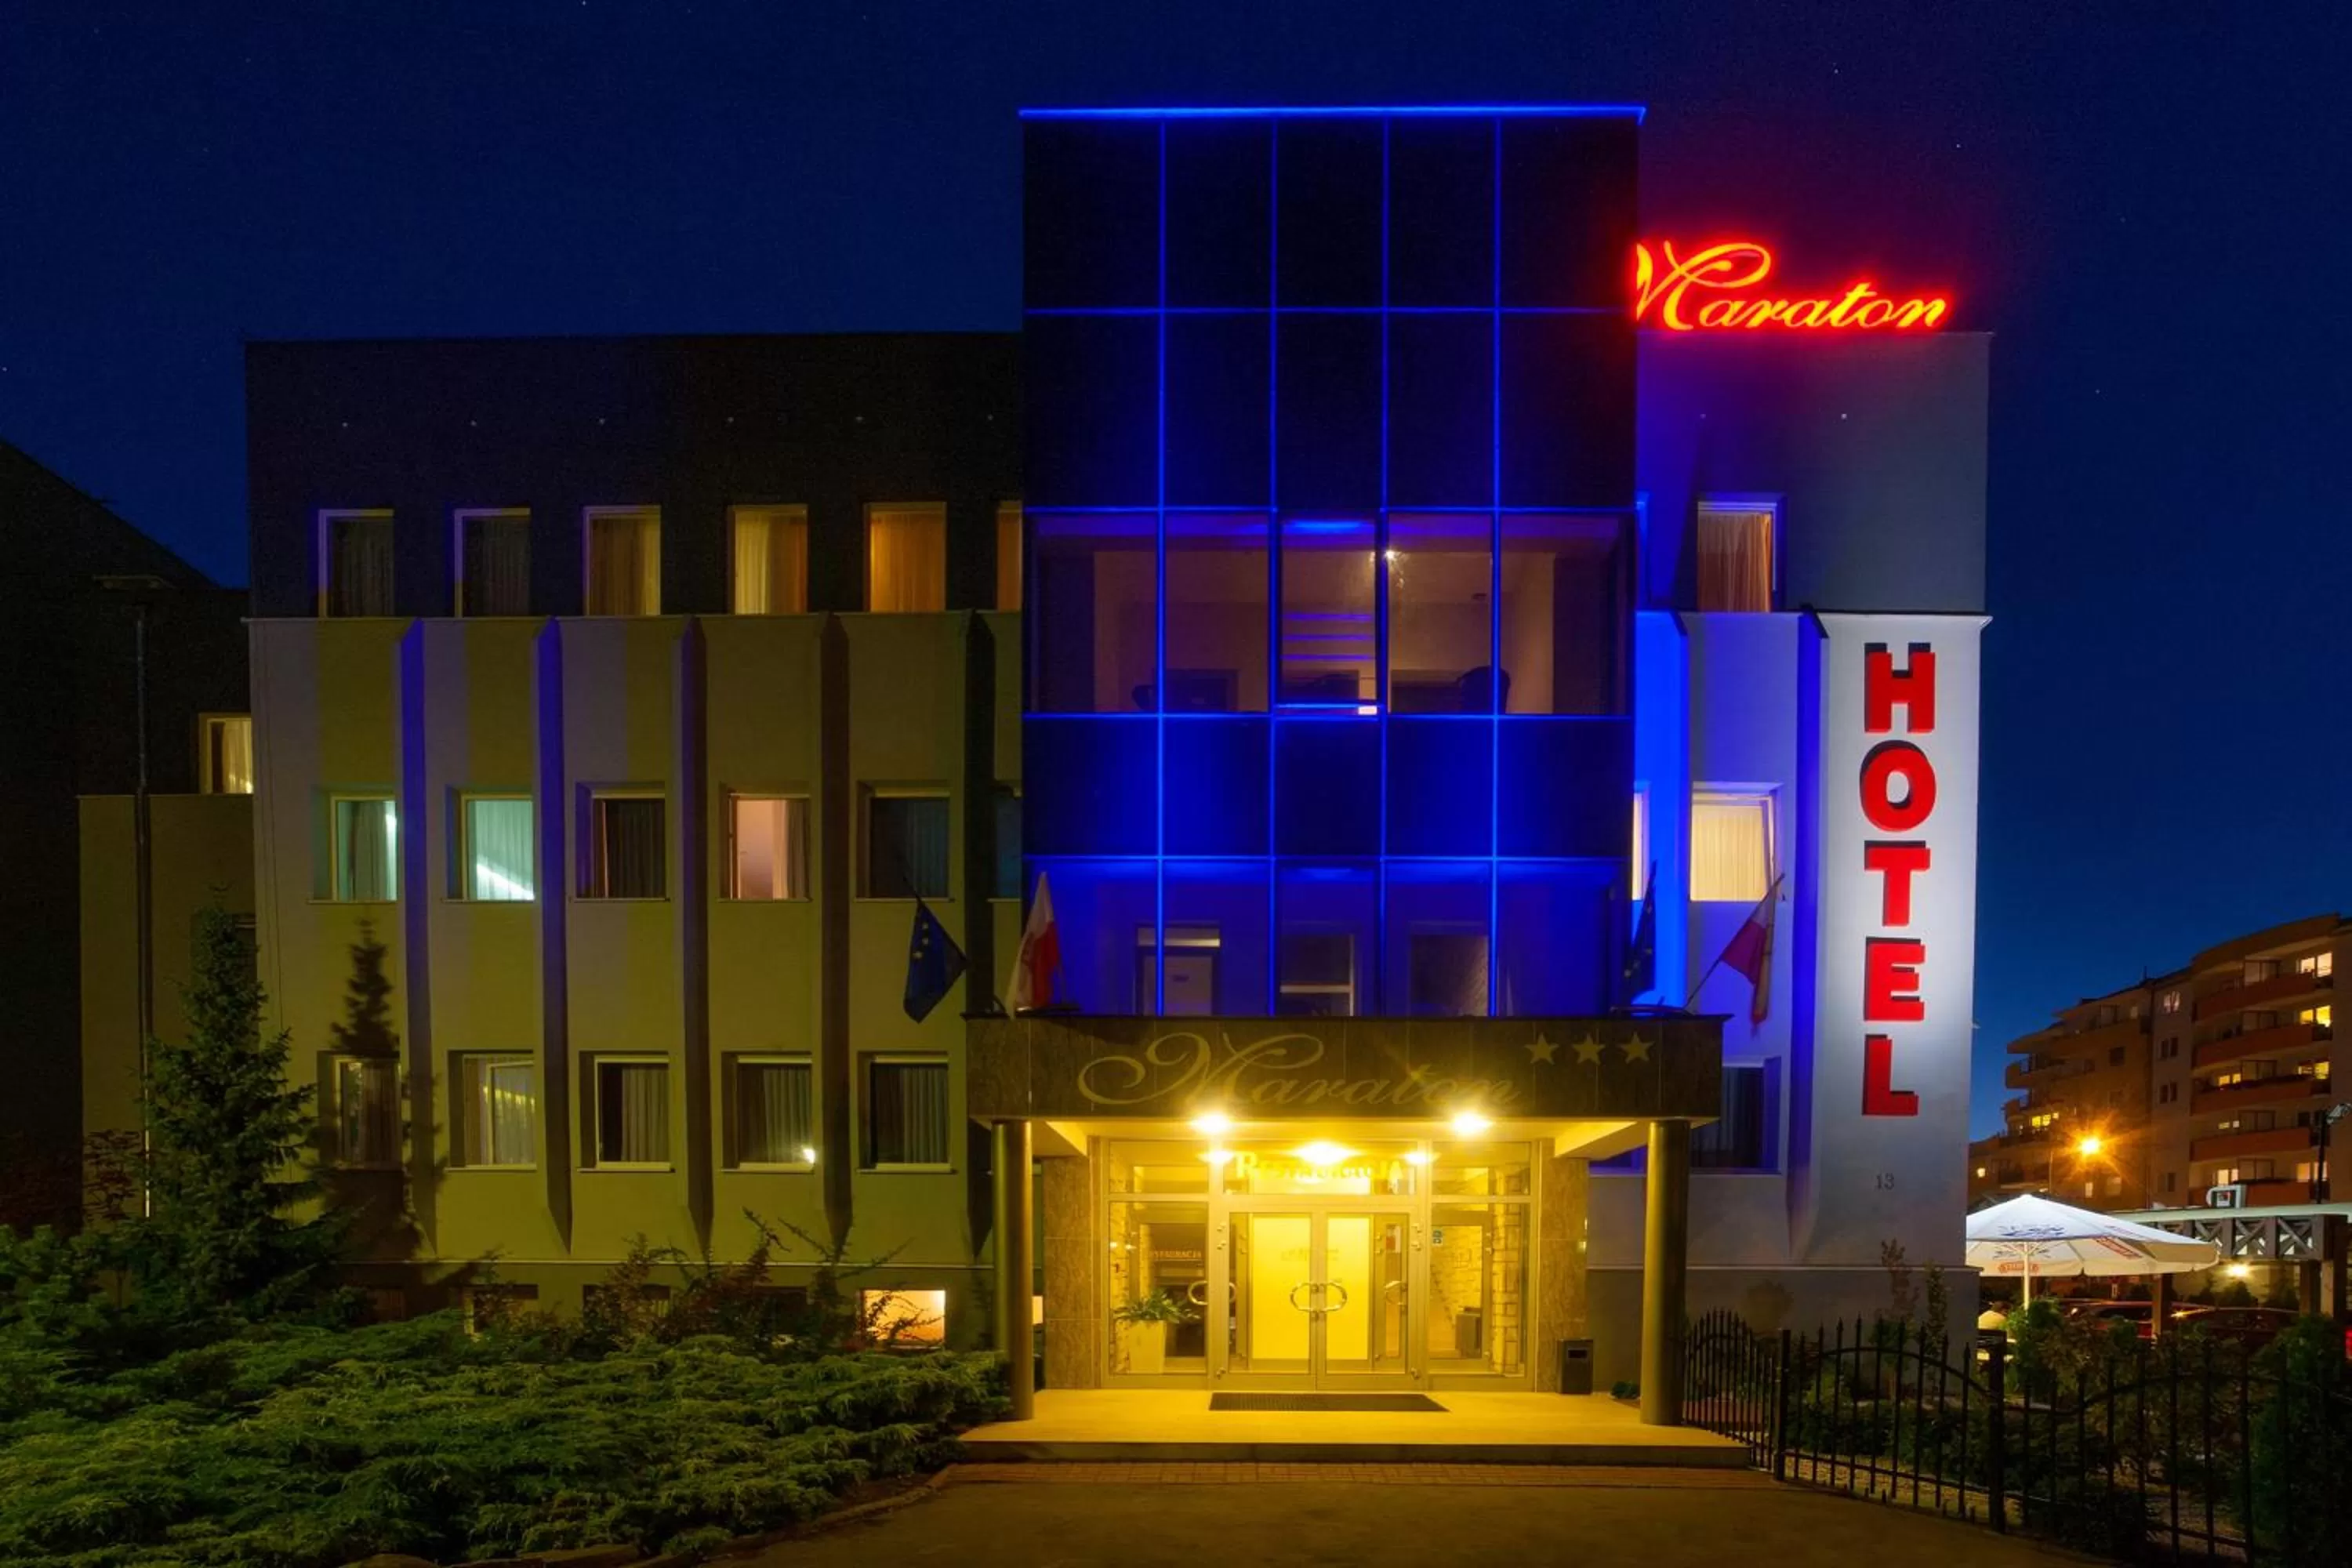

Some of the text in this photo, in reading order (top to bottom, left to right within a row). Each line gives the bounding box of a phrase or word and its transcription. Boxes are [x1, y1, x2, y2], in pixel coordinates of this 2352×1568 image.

[1859, 642, 1936, 1117] HOTEL
[1077, 1032, 1522, 1105] Maraton
[1875, 1172, 1895, 1190] 13
